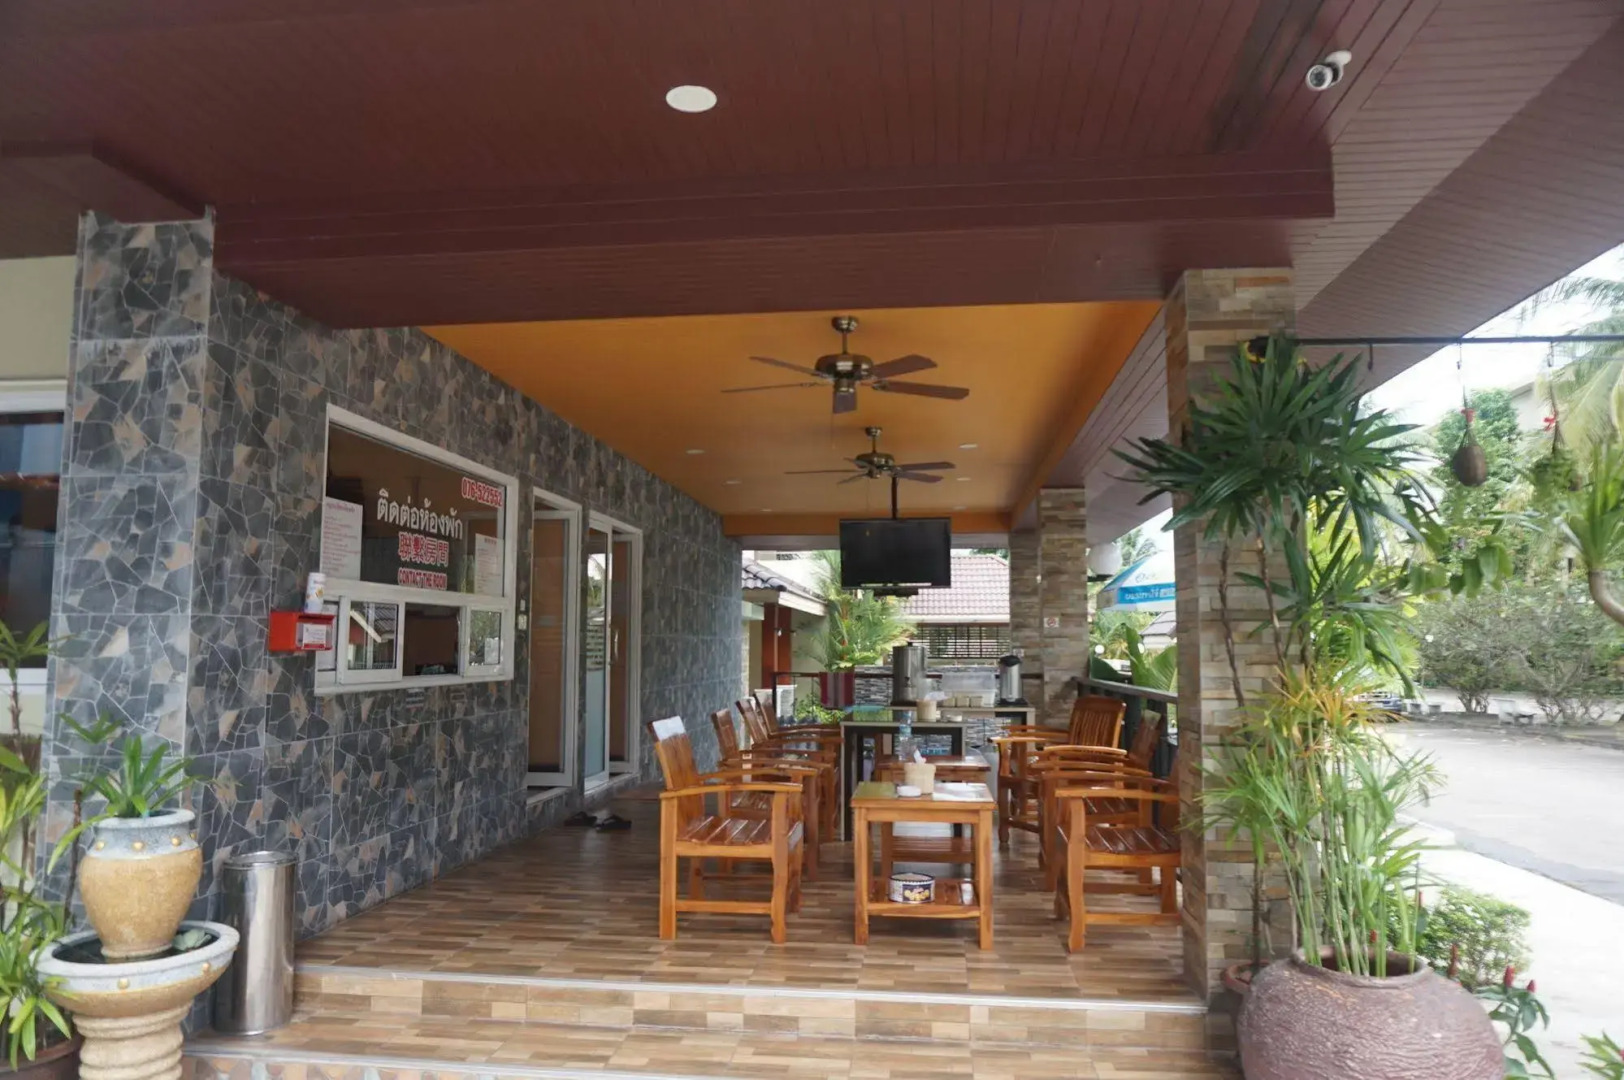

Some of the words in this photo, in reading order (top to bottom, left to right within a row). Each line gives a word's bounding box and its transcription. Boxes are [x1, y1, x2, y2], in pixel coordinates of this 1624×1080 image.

[377, 488, 463, 539] ติดต่อห้องพัก
[398, 567, 423, 588] CONTACT
[423, 571, 432, 589] THE
[433, 572, 447, 590] ROOM
